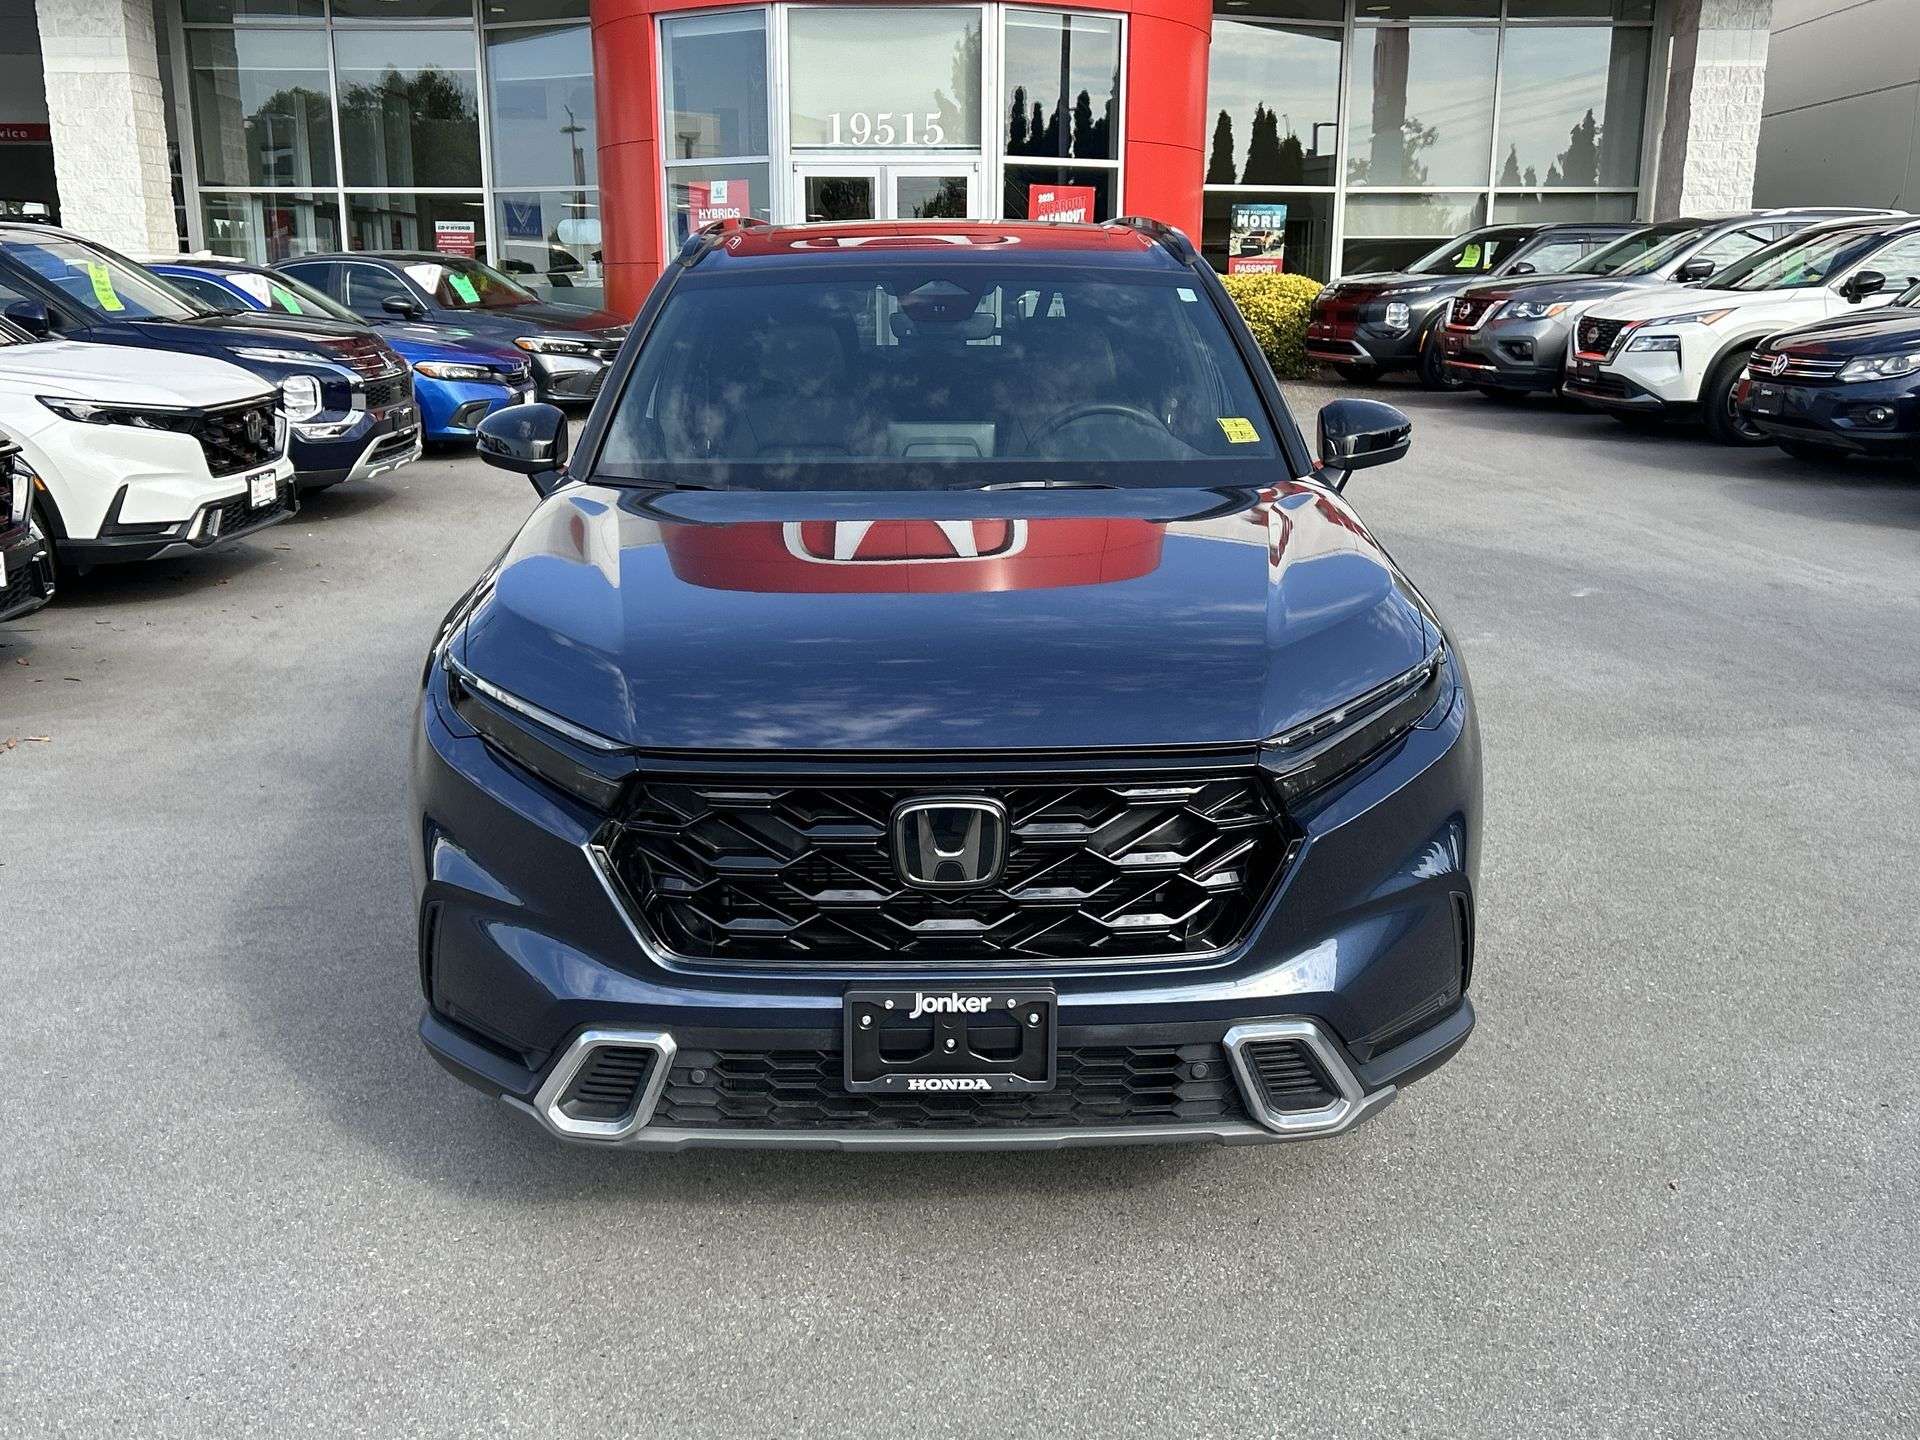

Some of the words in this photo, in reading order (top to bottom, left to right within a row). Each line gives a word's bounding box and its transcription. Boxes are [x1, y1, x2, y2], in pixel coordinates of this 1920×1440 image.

[827, 111, 945, 146] 19515
[698, 208, 741, 219] HYBRIDS
[1236, 214, 1281, 228] MORE
[1234, 264, 1278, 273] PASSPORT
[909, 992, 992, 1019] Jonker
[907, 1078, 993, 1091] HONDA
